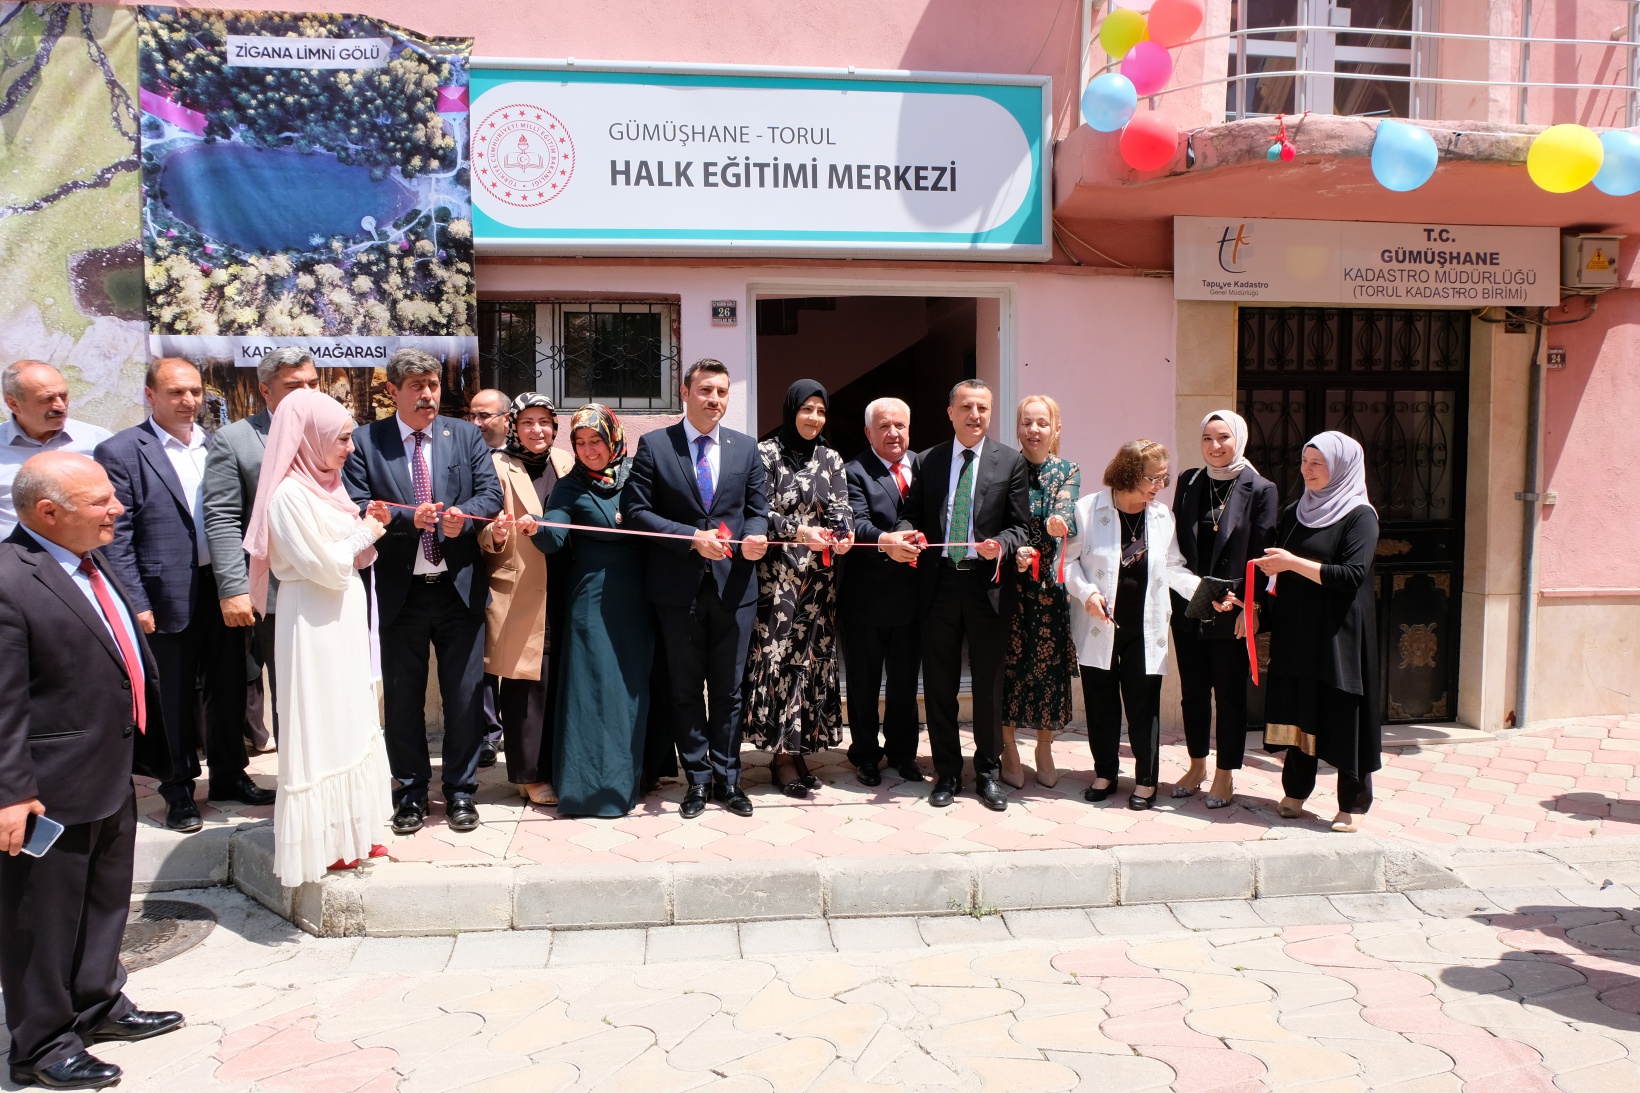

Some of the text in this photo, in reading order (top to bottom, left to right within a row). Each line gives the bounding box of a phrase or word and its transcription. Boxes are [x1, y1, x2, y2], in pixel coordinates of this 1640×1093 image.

[235, 43, 380, 60] ZİGANA LİMNİ GÖLÜ
[608, 119, 750, 147] GÜMÜŞHANE
[766, 126, 837, 145] TORUL
[610, 155, 957, 192] HALK EĞİTİMİ MERKEZİ
[1423, 228, 1456, 243] T.C.
[1380, 247, 1500, 268] GÜMÜŞHANE
[1202, 279, 1221, 289] Tapu
[1233, 280, 1269, 289] Kadastro
[1344, 267, 1537, 285] KADASTRO MÜDÜRLÜĞÜ
[1228, 289, 1259, 298] Müdürlüğü
[1353, 285, 1528, 302] (TORUL KADASTRO BİRİMİ)
[718, 307, 731, 317] 26
[309, 343, 387, 359] MAĞARASI
[1551, 354, 1561, 363] 24
